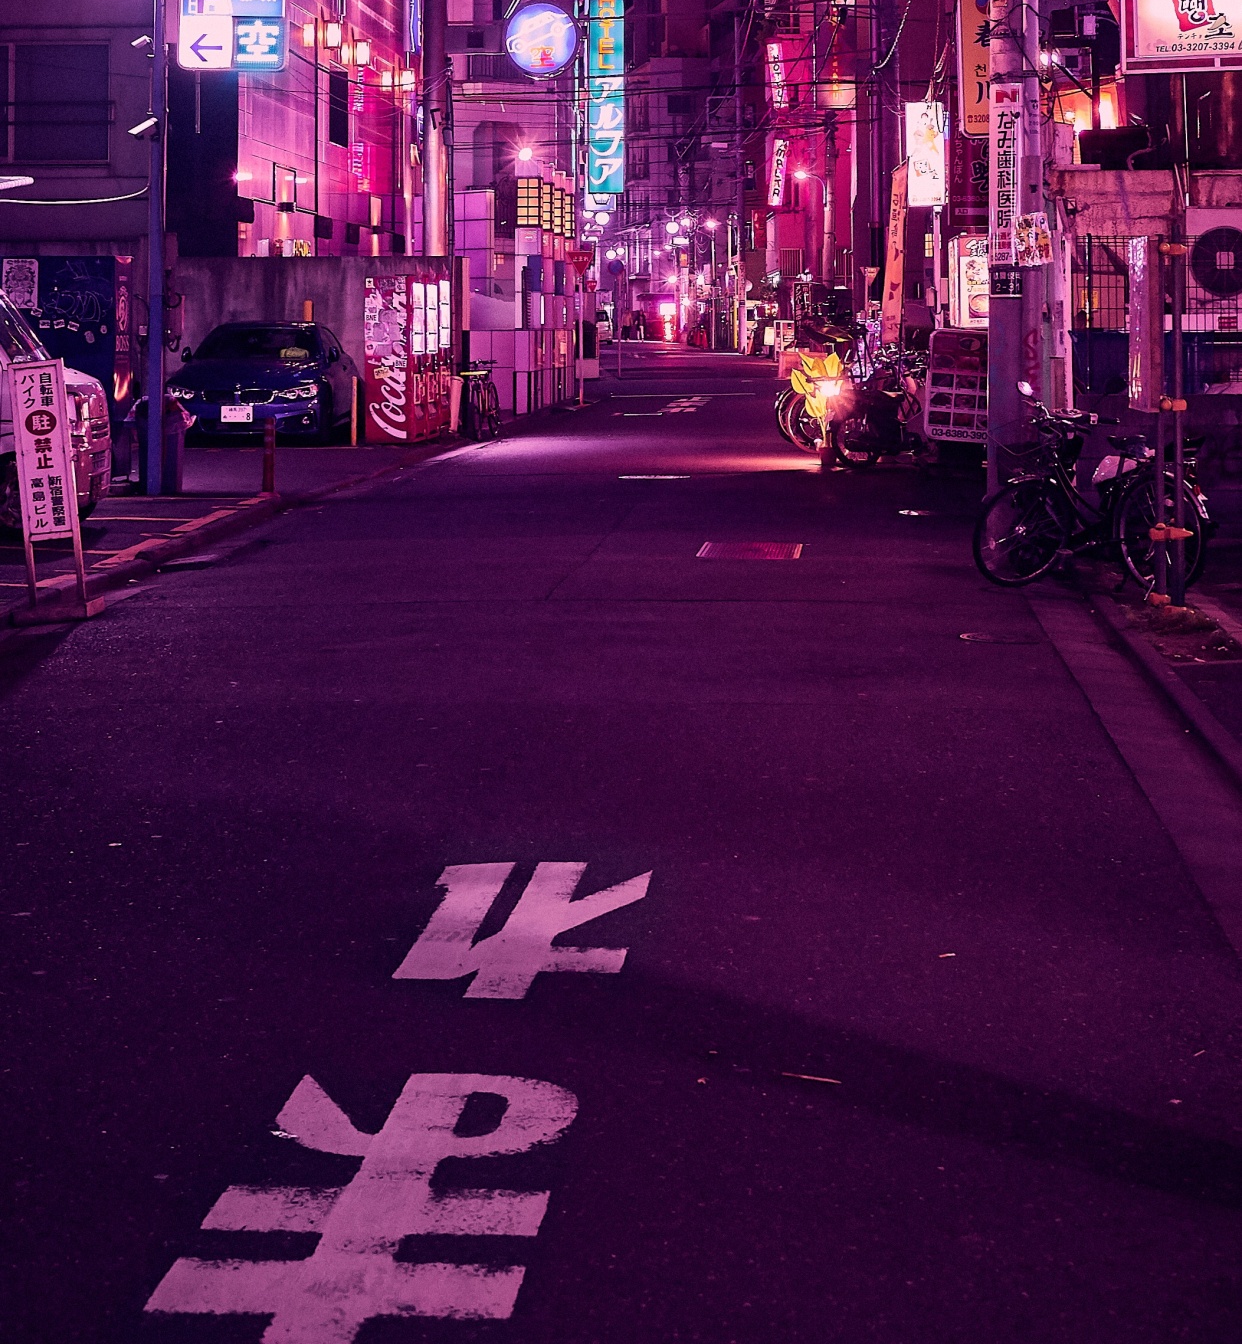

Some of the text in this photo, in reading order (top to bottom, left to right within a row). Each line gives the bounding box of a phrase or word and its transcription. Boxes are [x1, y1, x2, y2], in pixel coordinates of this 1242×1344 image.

[236, 19, 280, 62] 空
[997, 111, 1018, 228] なみ歯科医院
[20, 374, 37, 409] バイク
[39, 372, 54, 407] 自転車
[30, 477, 49, 529] 高島ビル
[48, 475, 67, 526] 新宿警察署
